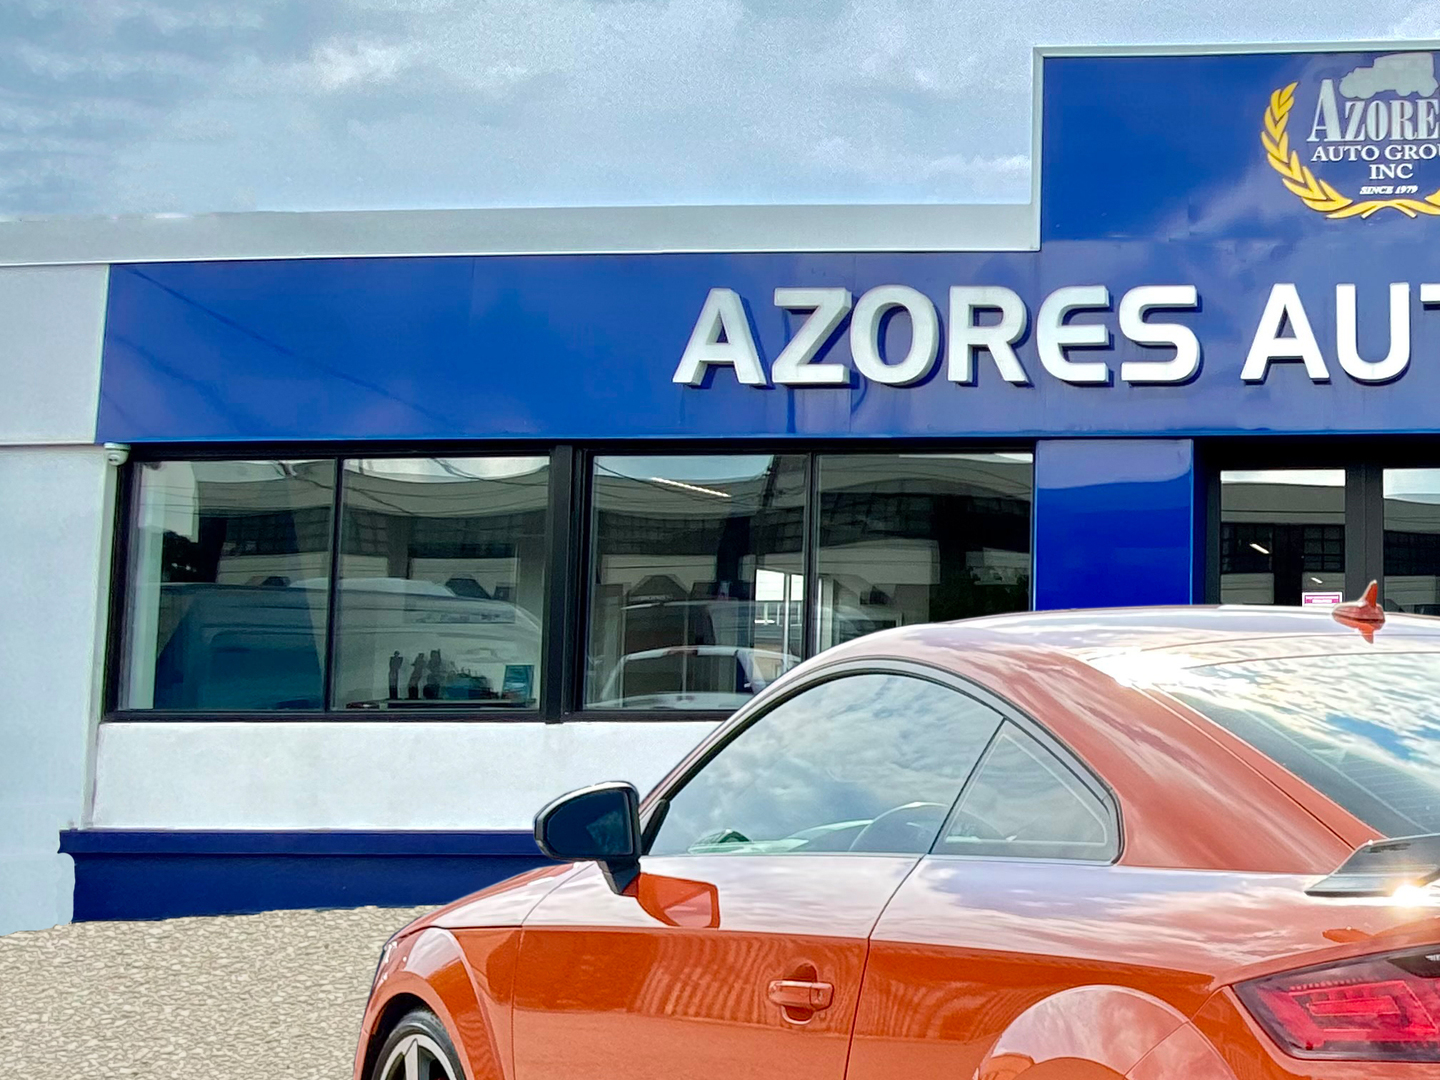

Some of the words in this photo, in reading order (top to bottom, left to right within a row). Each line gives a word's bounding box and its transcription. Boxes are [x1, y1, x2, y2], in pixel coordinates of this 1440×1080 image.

[1311, 144, 1380, 162] AUTO
[1369, 163, 1414, 180] INC
[1359, 186, 1394, 195] SINCE
[1395, 185, 1418, 194] 1979
[672, 284, 1202, 388] AZORES
